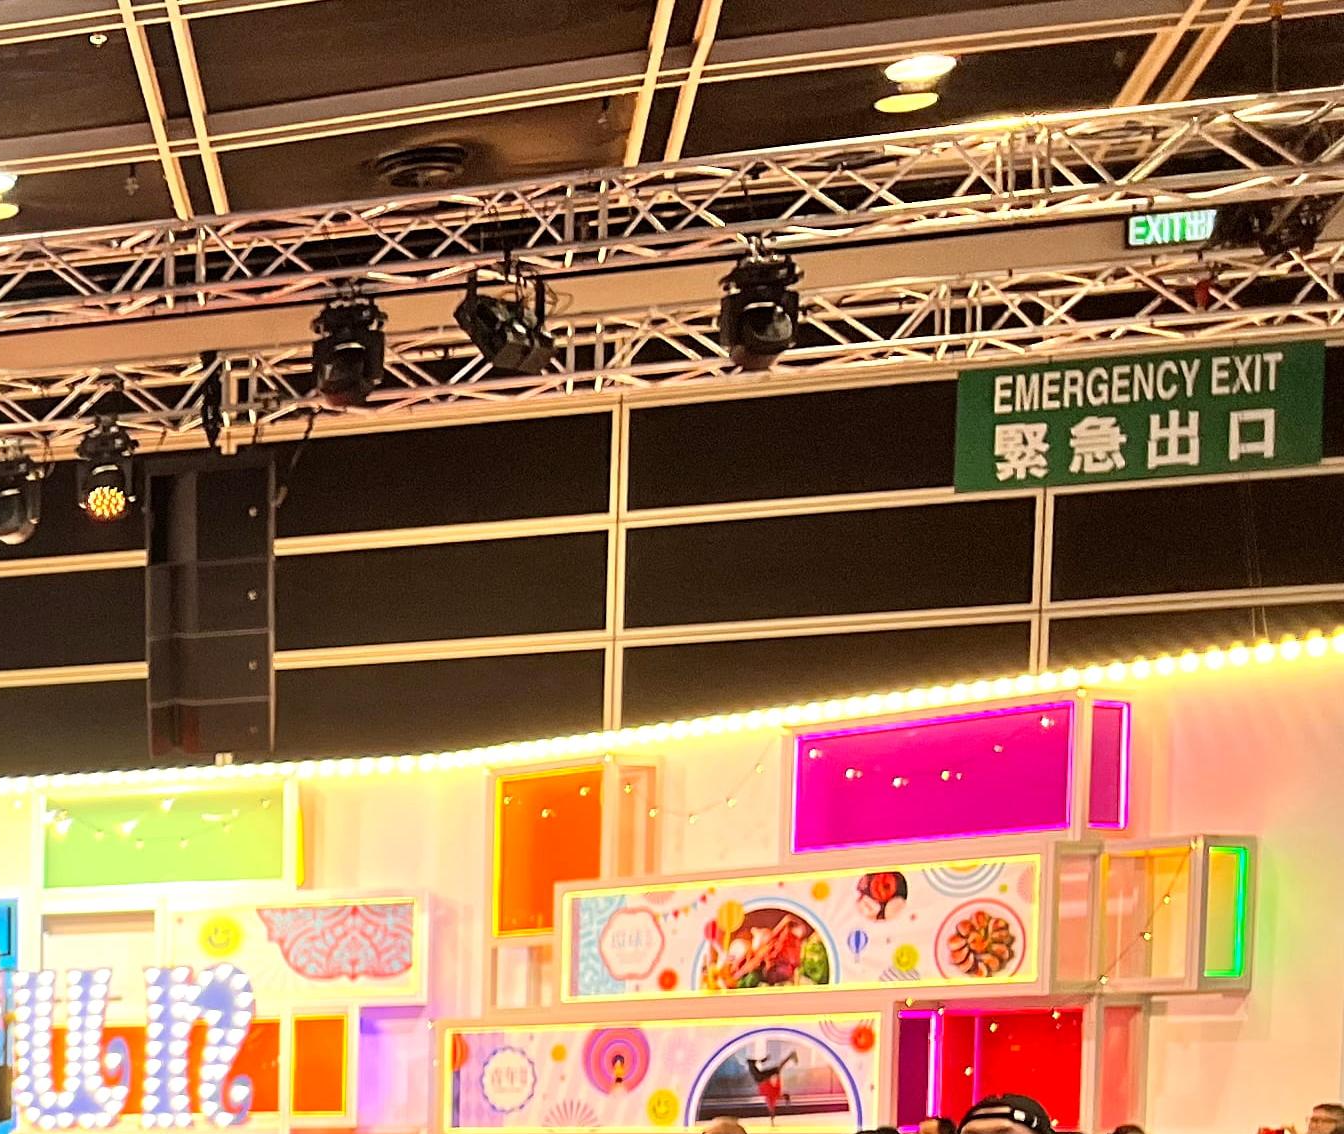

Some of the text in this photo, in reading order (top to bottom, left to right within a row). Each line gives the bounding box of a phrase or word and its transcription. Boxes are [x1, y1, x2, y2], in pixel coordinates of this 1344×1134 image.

[1129, 213, 1185, 246] EXIT
[994, 352, 1284, 414] EMERGENCY EXIT
[994, 408, 1277, 481] 緊急出口
